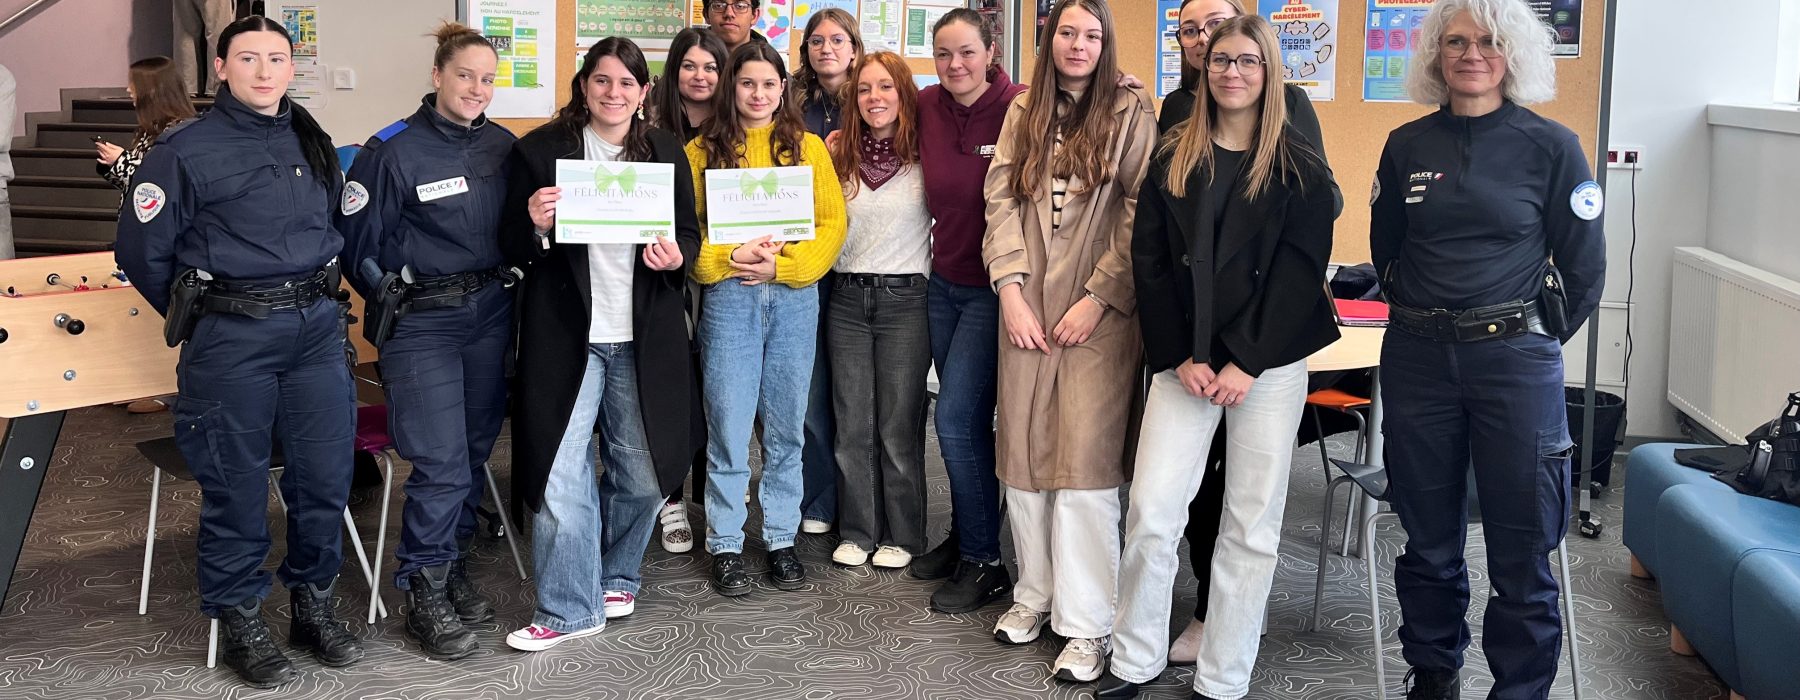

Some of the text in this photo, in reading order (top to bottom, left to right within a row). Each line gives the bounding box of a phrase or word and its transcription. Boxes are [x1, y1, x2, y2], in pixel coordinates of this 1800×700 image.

[1410, 171, 1433, 179] POLICE
[142, 187, 156, 195] POLICE
[347, 184, 365, 198] POLICE
[419, 183, 452, 194] POLICE
[137, 190, 161, 200] NATIONALE
